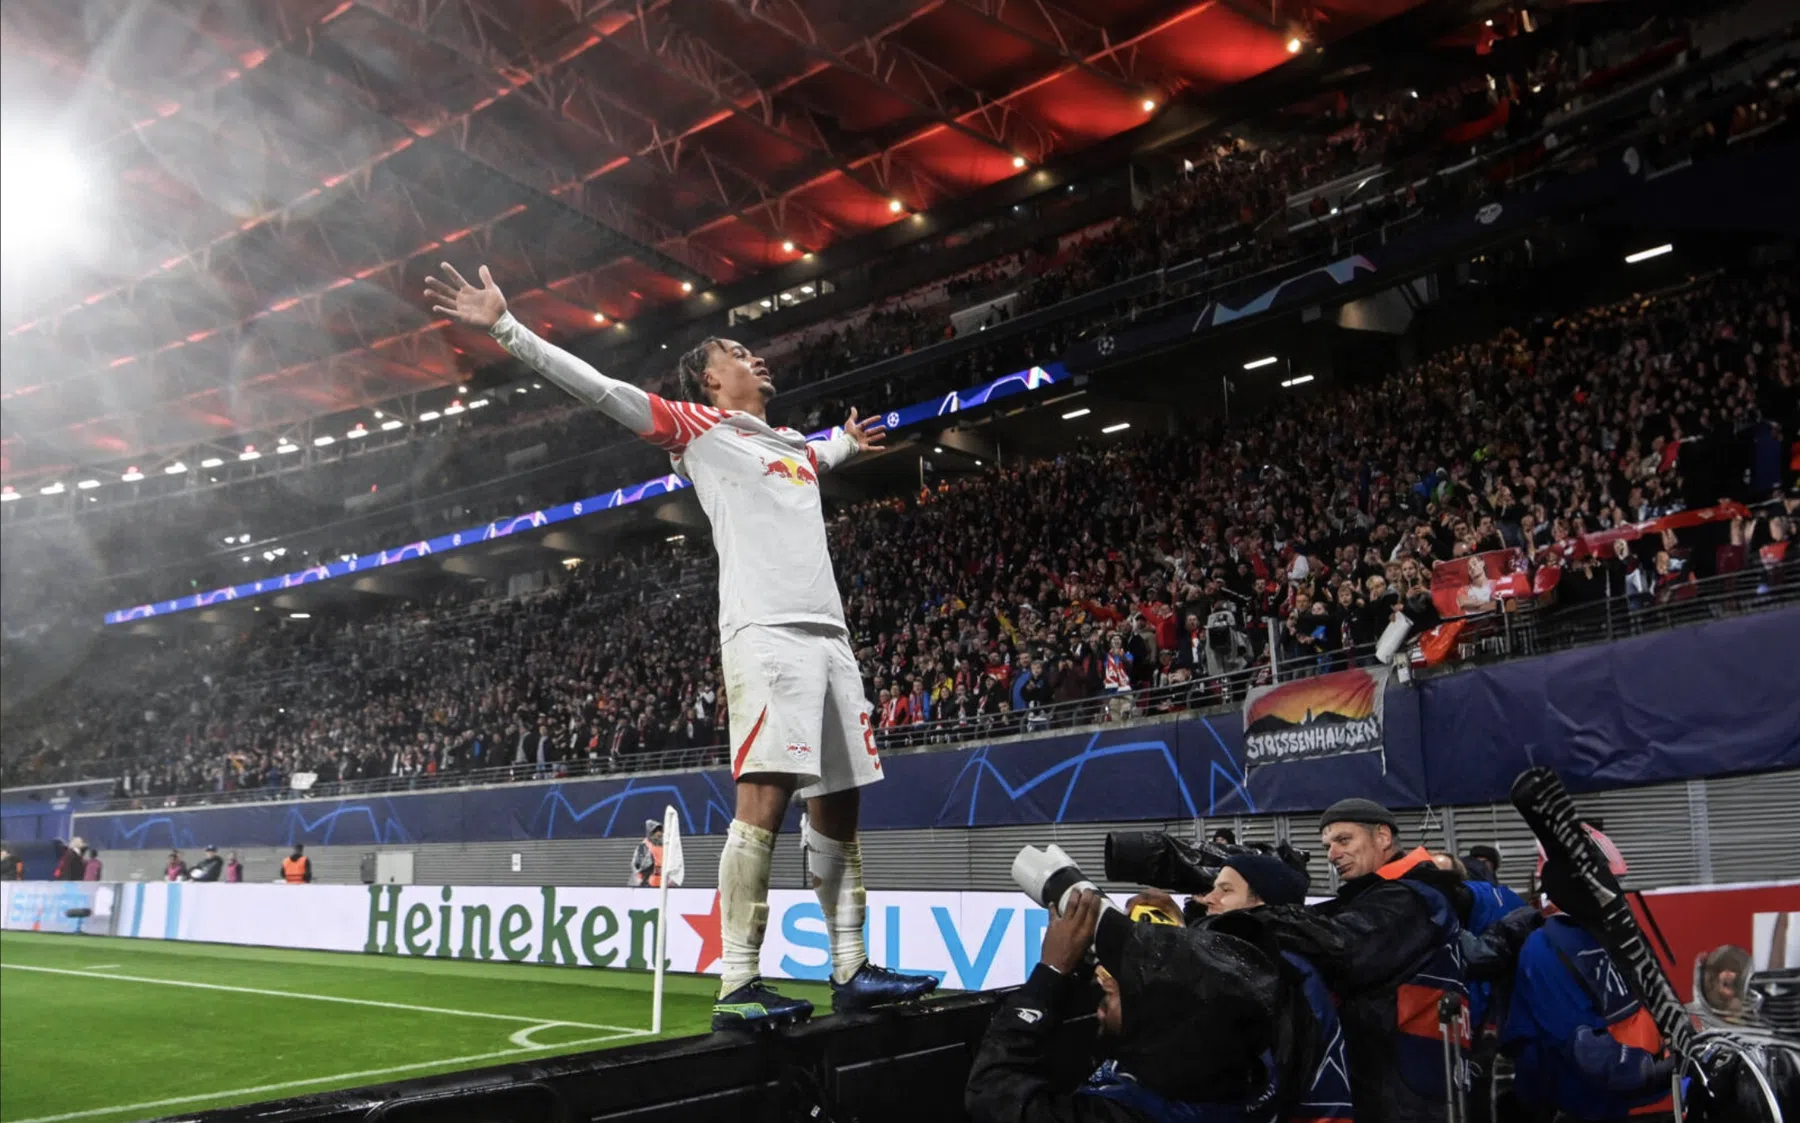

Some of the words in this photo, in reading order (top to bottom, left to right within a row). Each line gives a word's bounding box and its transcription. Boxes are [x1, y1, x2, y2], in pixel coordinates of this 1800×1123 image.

[859, 711, 880, 770] 2
[1246, 716, 1378, 759] STRESSENHAUSEN
[363, 886, 671, 969] Heineken
